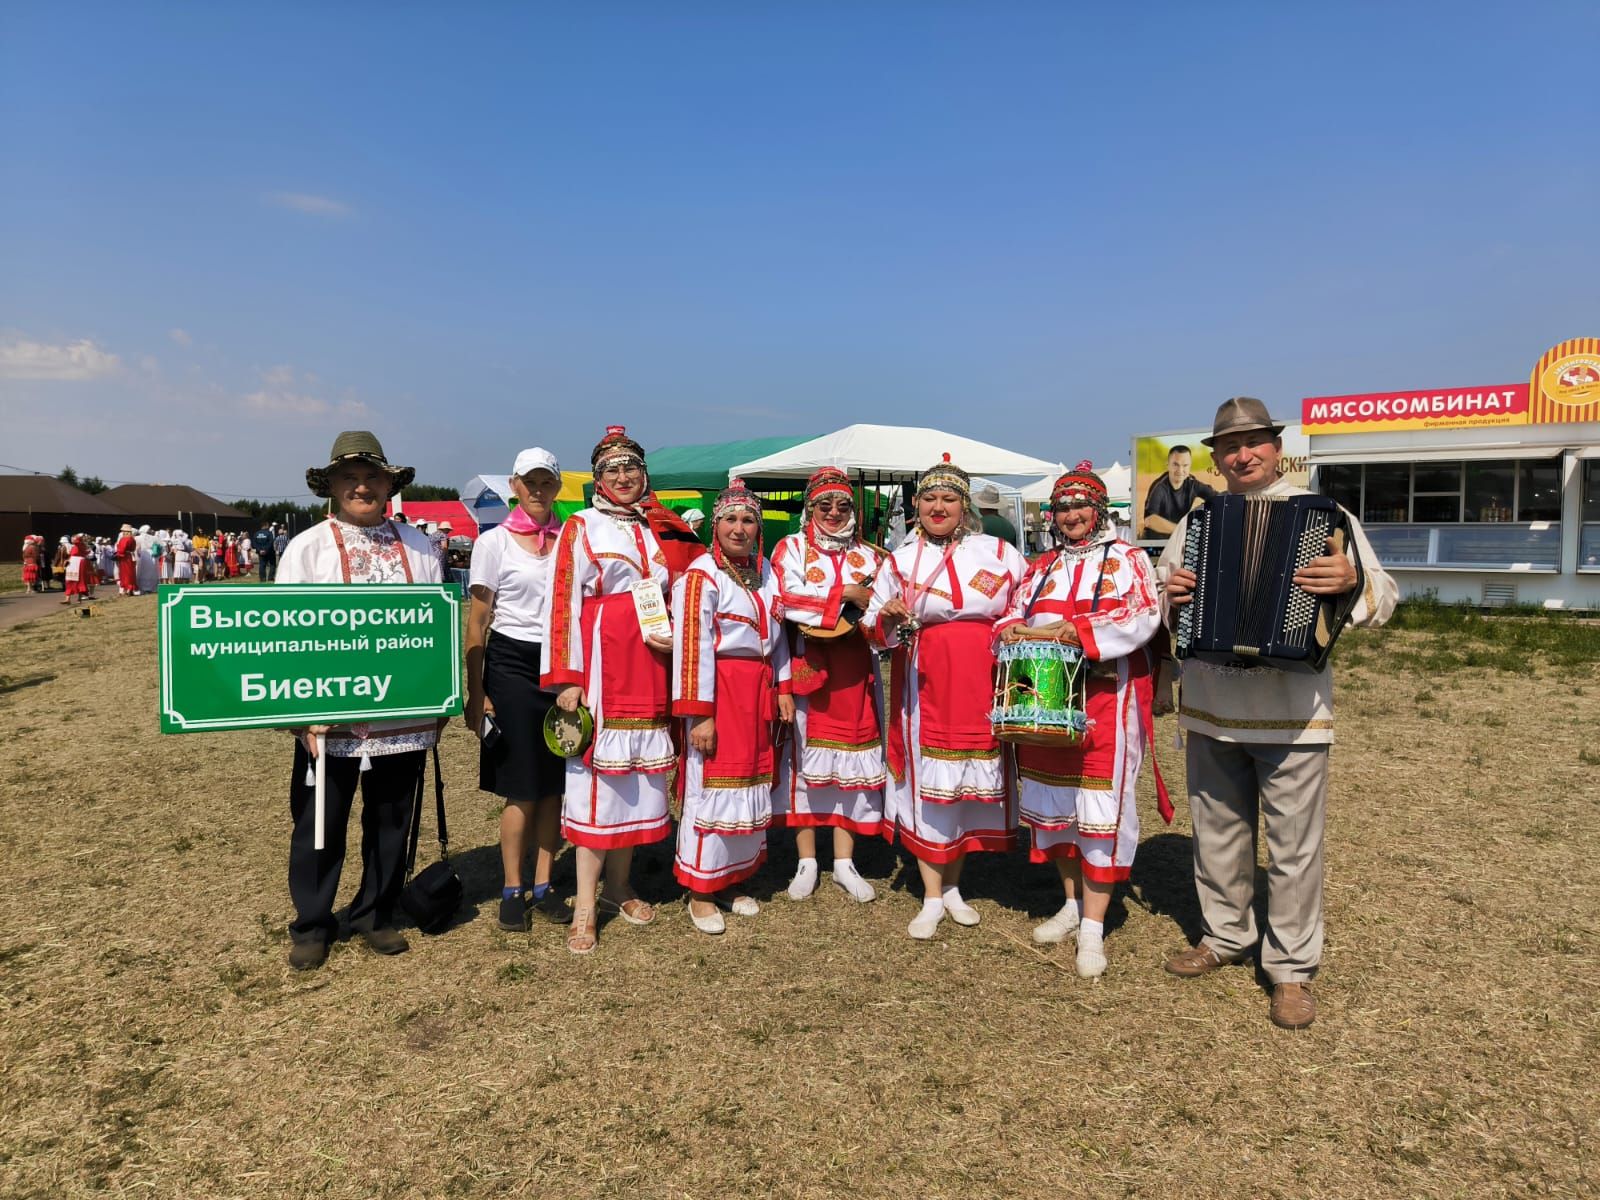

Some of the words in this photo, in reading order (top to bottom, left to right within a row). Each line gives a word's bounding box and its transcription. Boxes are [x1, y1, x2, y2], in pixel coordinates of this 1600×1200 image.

[1310, 391, 1516, 419] МЯСОКОМБИНАТ
[1424, 420, 1467, 428] фирменная
[1469, 417, 1510, 425] продукция
[190, 602, 434, 631] Высокогорский
[190, 635, 369, 659] муниципальный
[375, 634, 434, 653] район
[240, 673, 392, 702] Биектау
